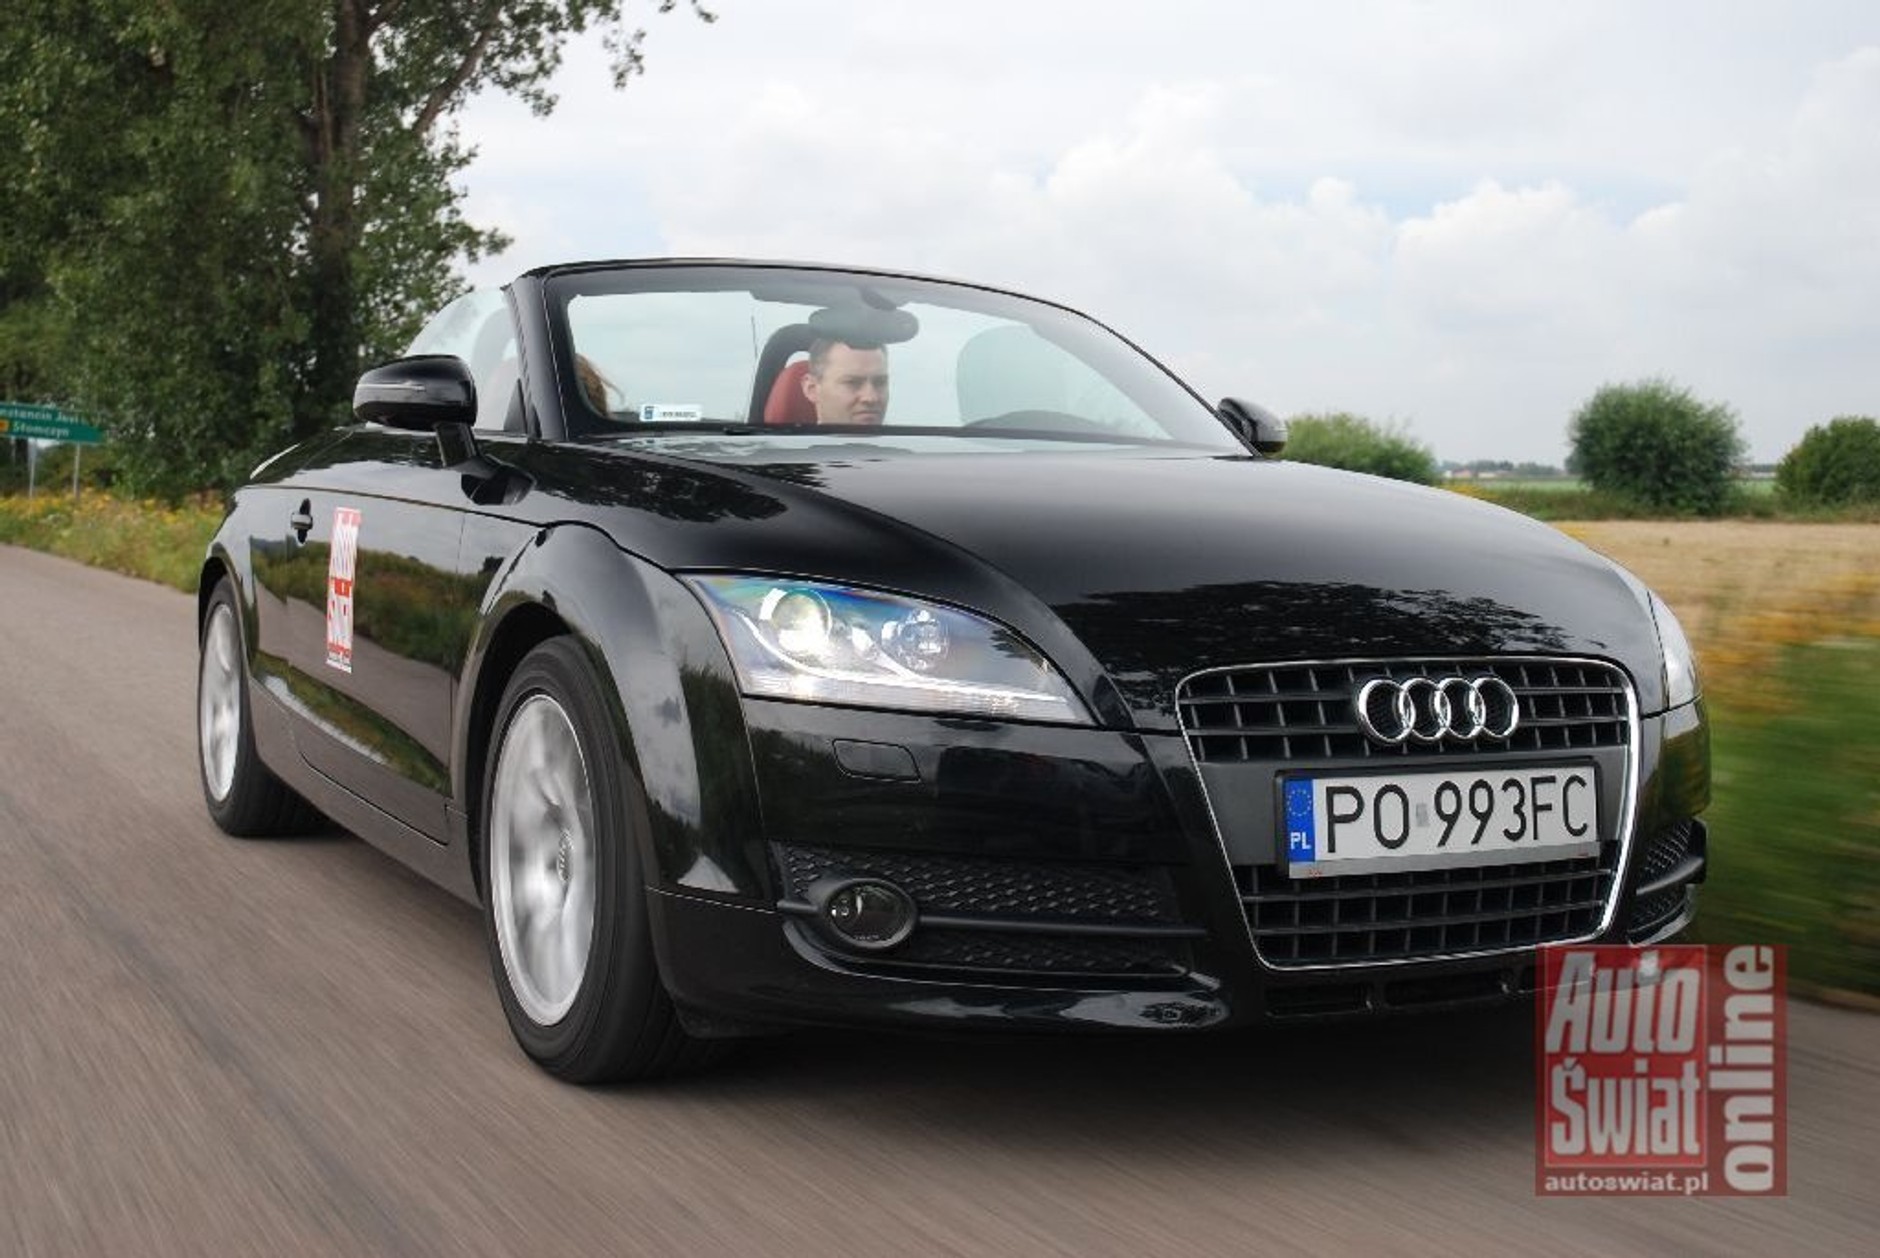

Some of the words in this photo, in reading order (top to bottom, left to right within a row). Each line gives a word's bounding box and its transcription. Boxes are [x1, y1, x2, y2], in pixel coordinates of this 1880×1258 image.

[1326, 784, 1409, 854] PO
[1433, 774, 1588, 848] 993FC
[1290, 832, 1310, 850] PL
